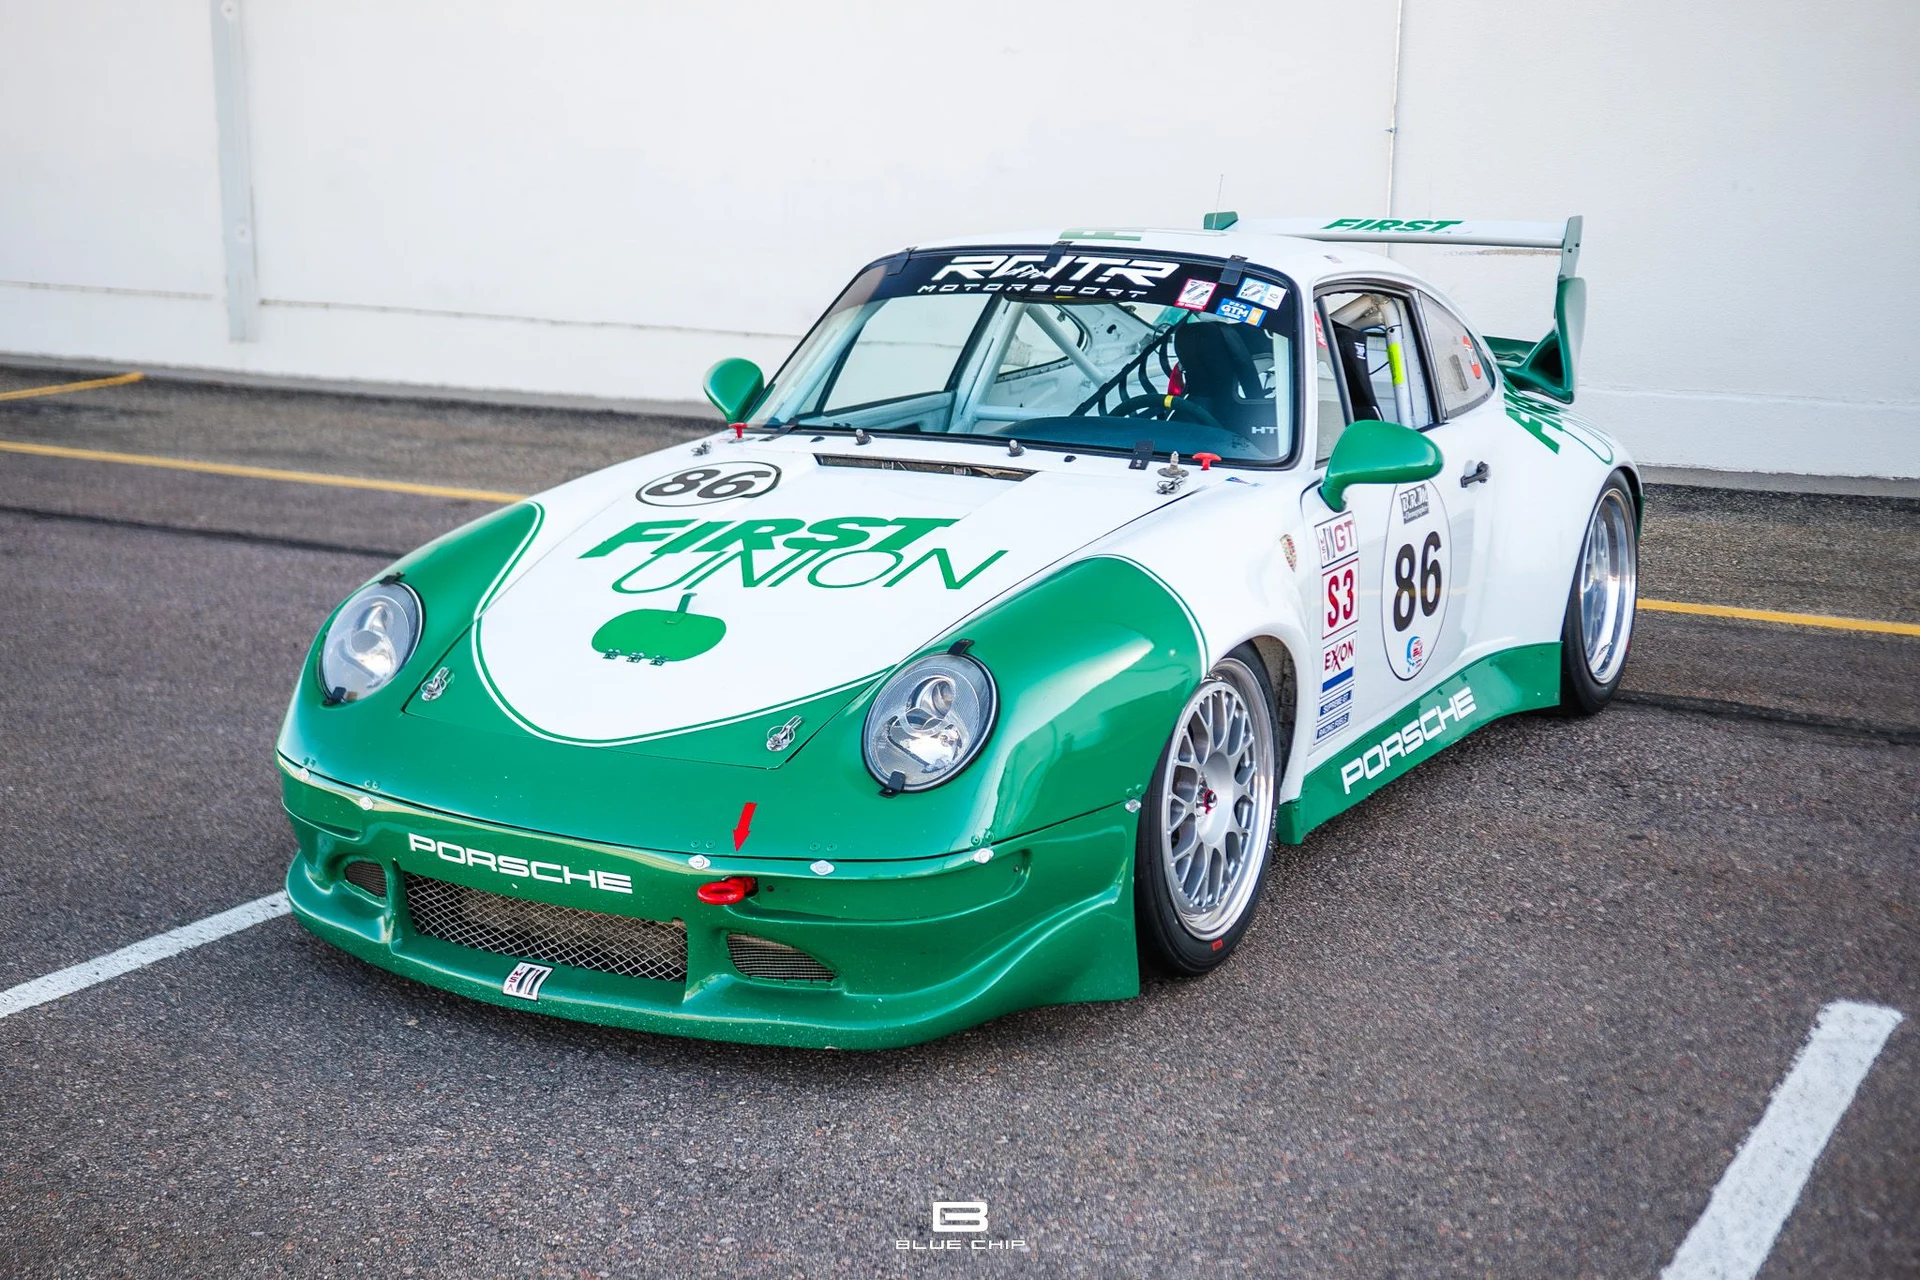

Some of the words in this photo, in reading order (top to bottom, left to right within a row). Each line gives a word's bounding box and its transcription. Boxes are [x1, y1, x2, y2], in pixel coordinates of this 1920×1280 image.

[1320, 218, 1464, 232] FIRST
[917, 283, 1147, 298] MOTORSPORT
[1220, 303, 1250, 318] GTM
[645, 468, 773, 499] 86
[577, 516, 962, 560] FIRST
[1334, 520, 1353, 552] GT
[611, 548, 1010, 594] UNION
[1393, 531, 1442, 632] 86
[1327, 568, 1354, 628] S3
[1324, 639, 1355, 672] EXXON
[1340, 686, 1477, 795] PORSCHE
[408, 832, 634, 895] PORSCHE
